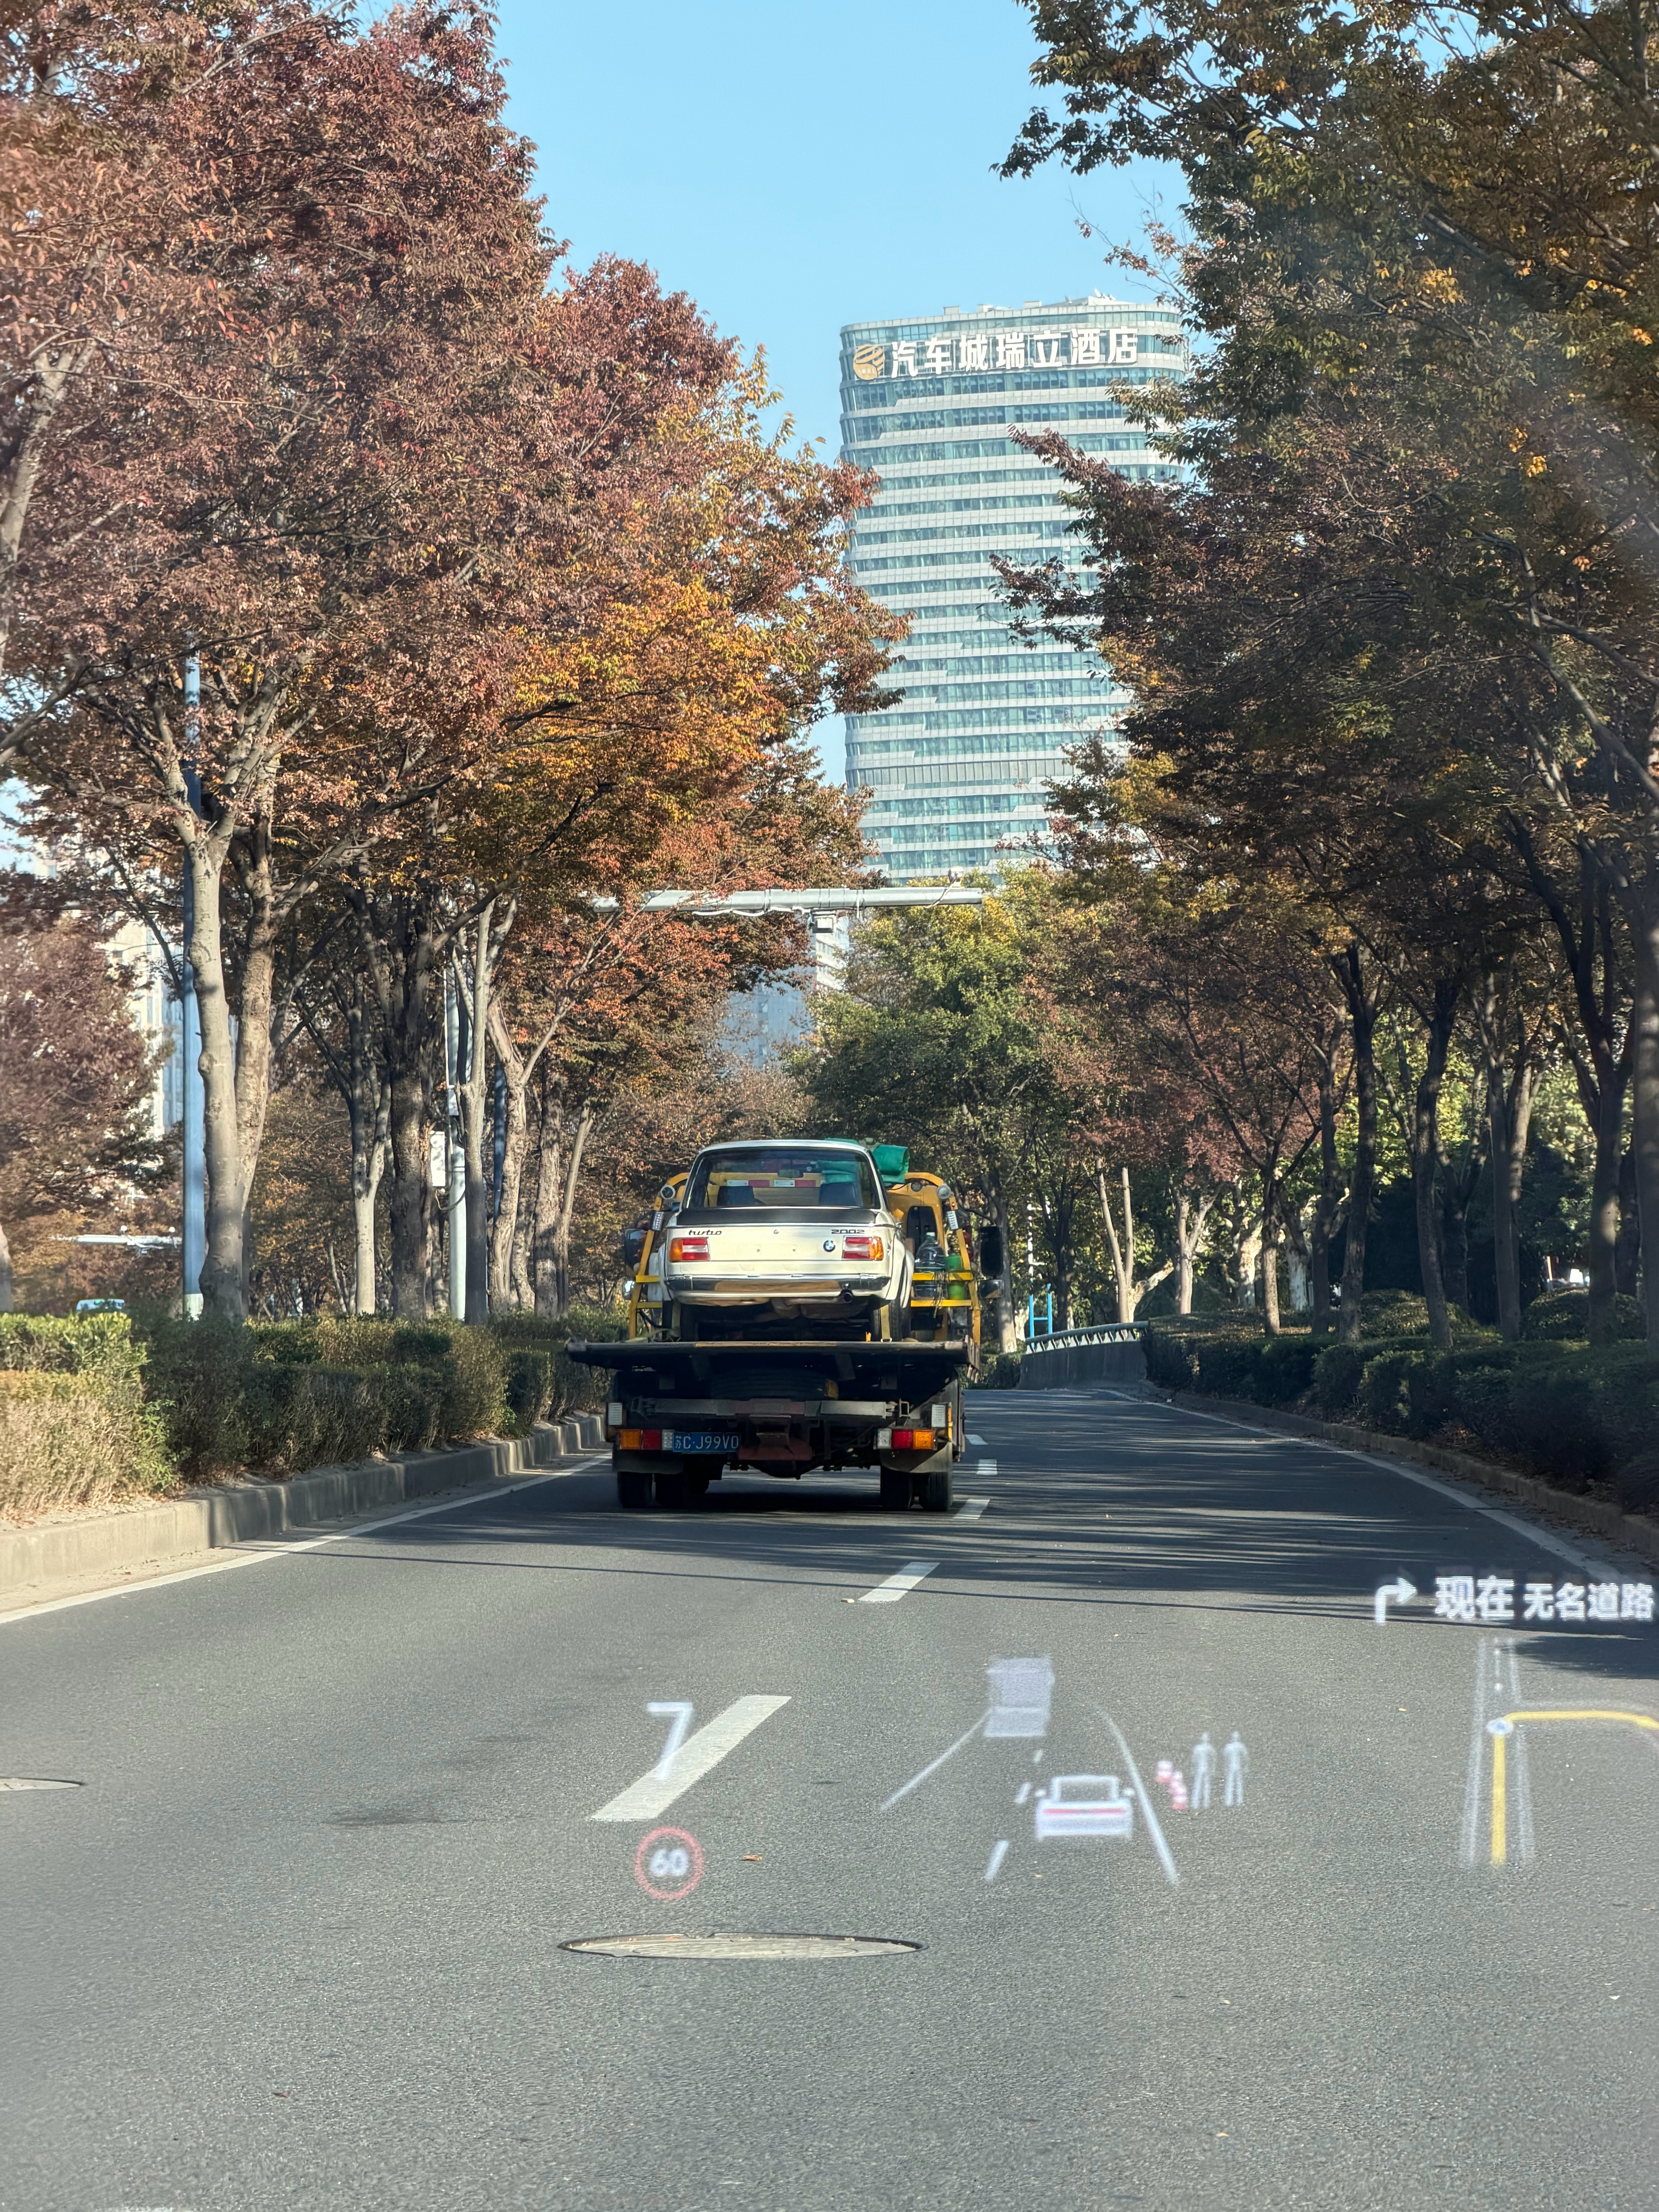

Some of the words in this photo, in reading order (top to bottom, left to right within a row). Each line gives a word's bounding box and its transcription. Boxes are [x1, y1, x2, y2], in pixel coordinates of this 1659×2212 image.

[891, 328, 1138, 378] 汽车城瑞立酒店
[1435, 1575, 1514, 1620] 现在
[1523, 1582, 1654, 1621] 无名道路
[647, 1702, 693, 1780] 7
[650, 1848, 689, 1877] 60
